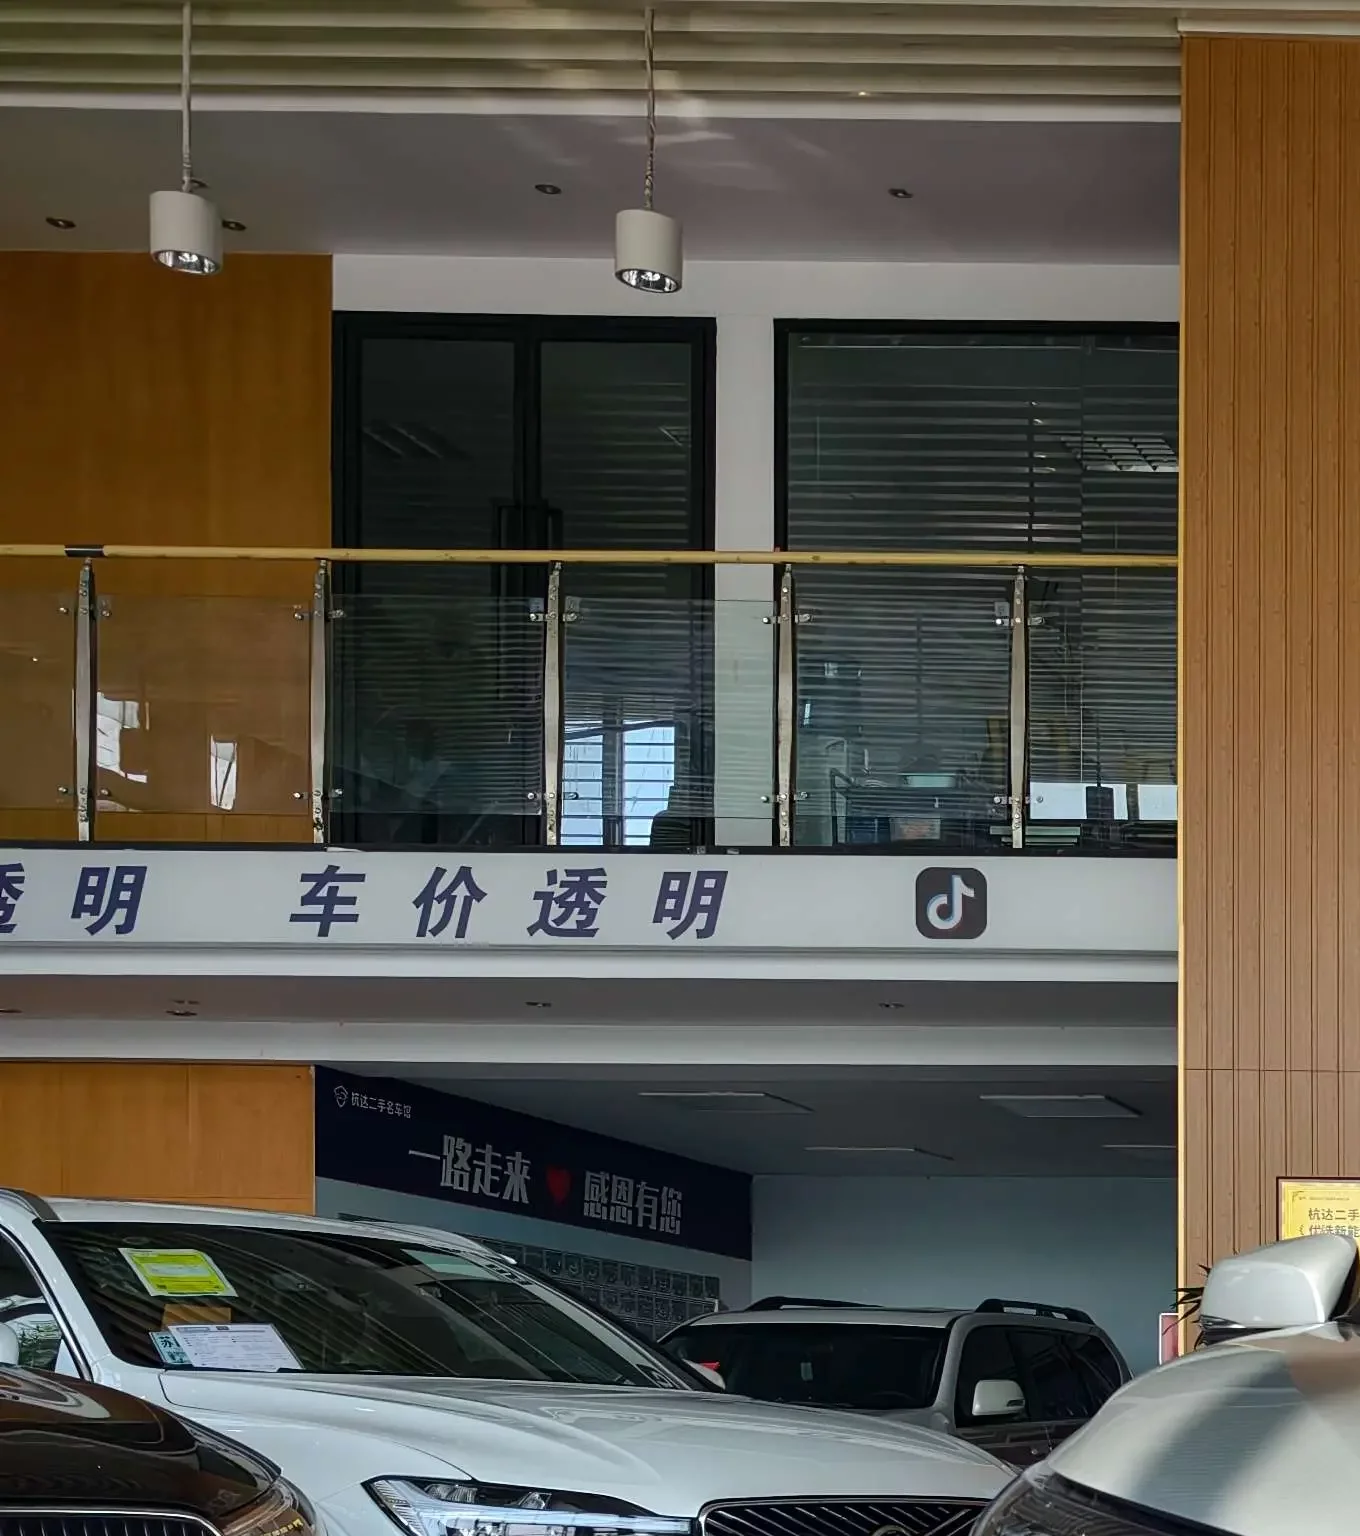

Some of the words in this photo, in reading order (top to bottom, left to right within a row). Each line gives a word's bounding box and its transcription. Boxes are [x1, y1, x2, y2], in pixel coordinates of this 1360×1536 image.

[289, 865, 729, 940] 车价透明
[408, 1134, 532, 1205] 一路走来
[583, 1170, 683, 1236] 感恩有您
